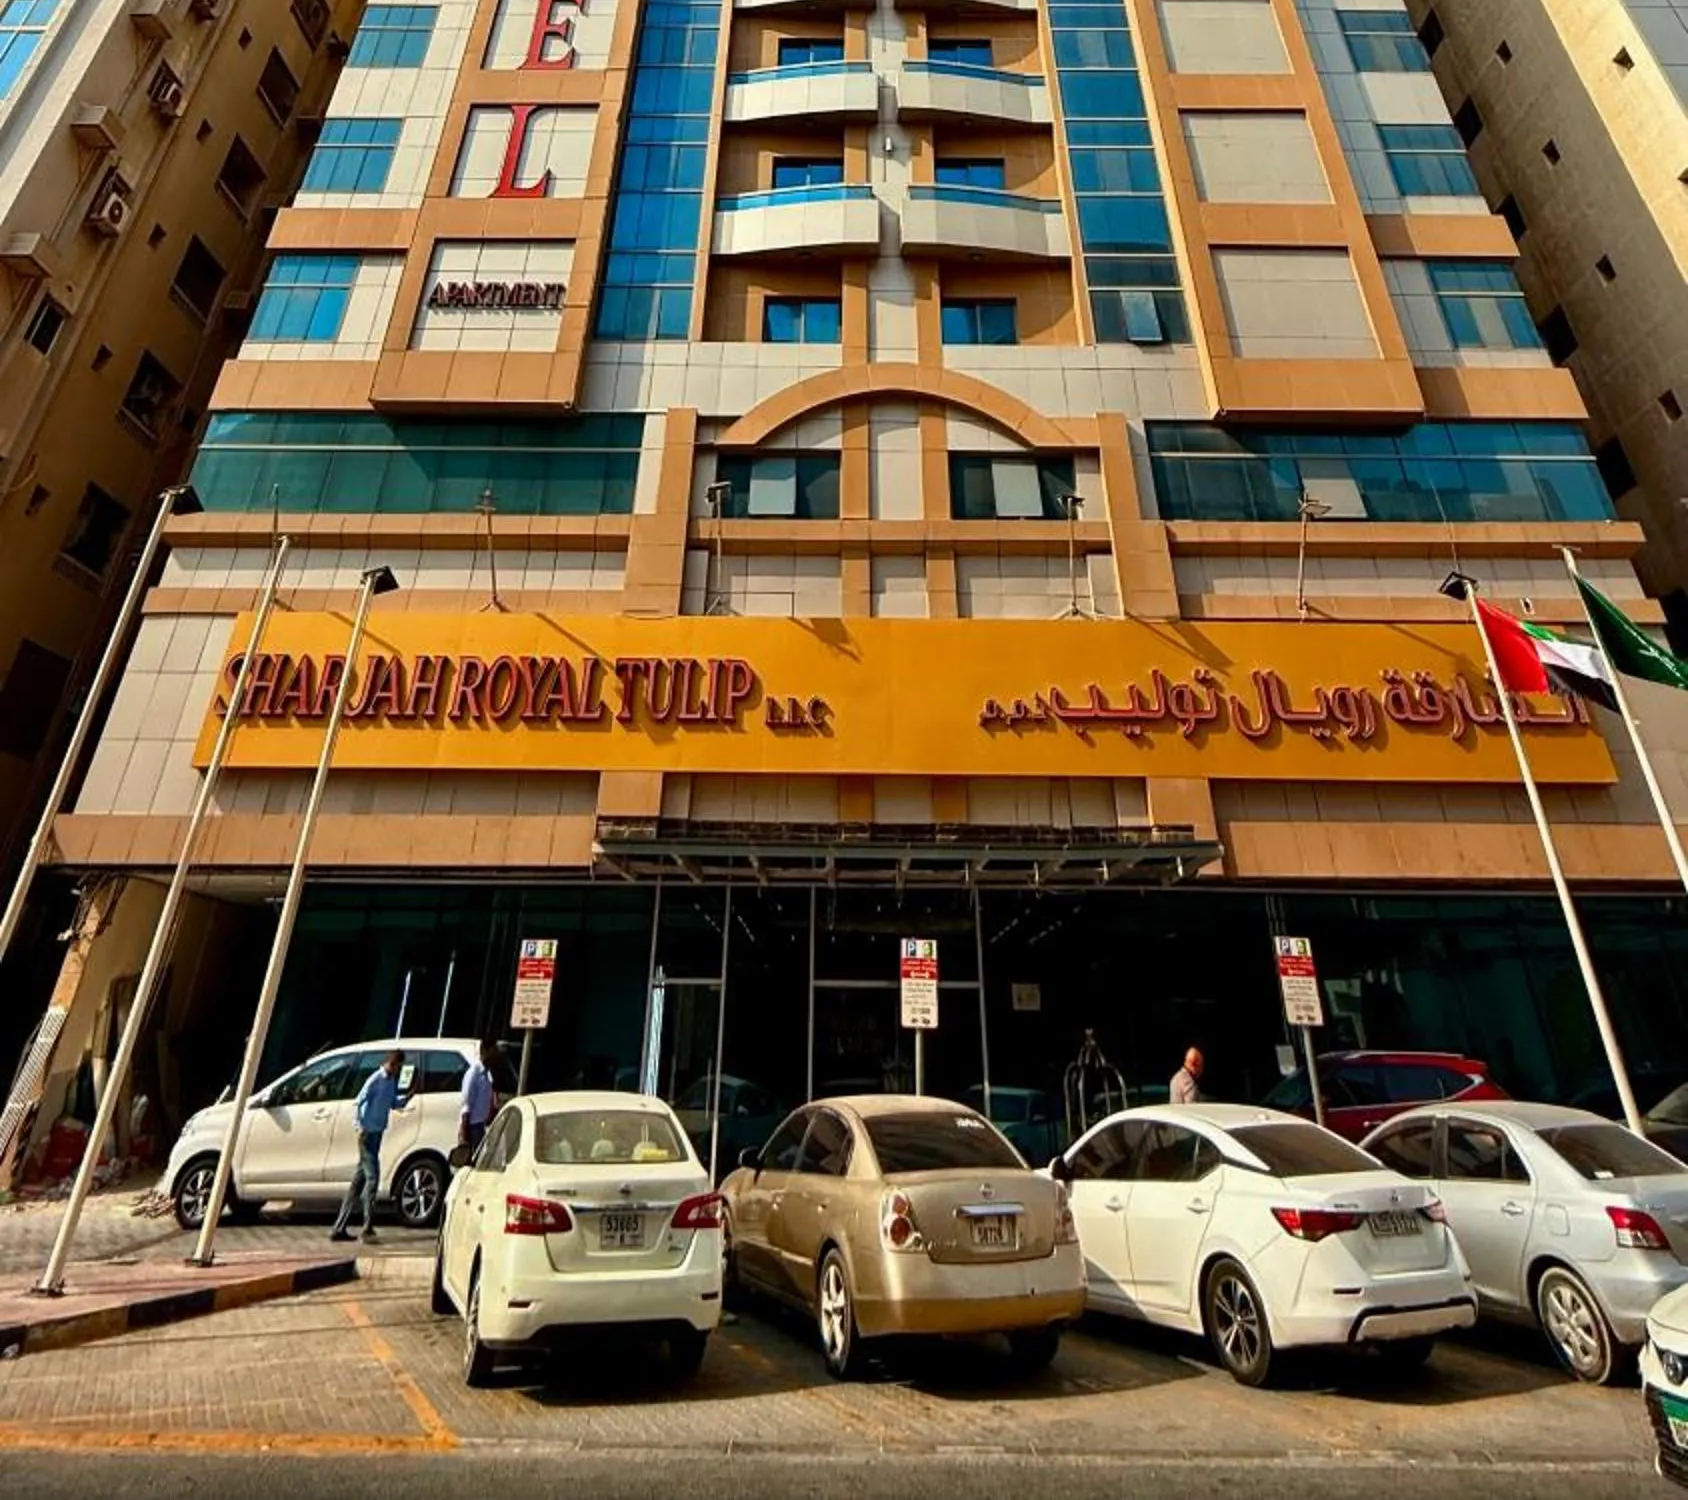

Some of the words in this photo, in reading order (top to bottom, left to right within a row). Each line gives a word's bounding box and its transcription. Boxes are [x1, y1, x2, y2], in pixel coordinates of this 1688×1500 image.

[430, 282, 567, 309] APARTMENT
[213, 652, 452, 718] SHARJAH
[449, 655, 604, 722] ROYAL
[615, 657, 753, 724] TULIP
[1050, 668, 1221, 737] توليب
[1229, 669, 1377, 738] رويال
